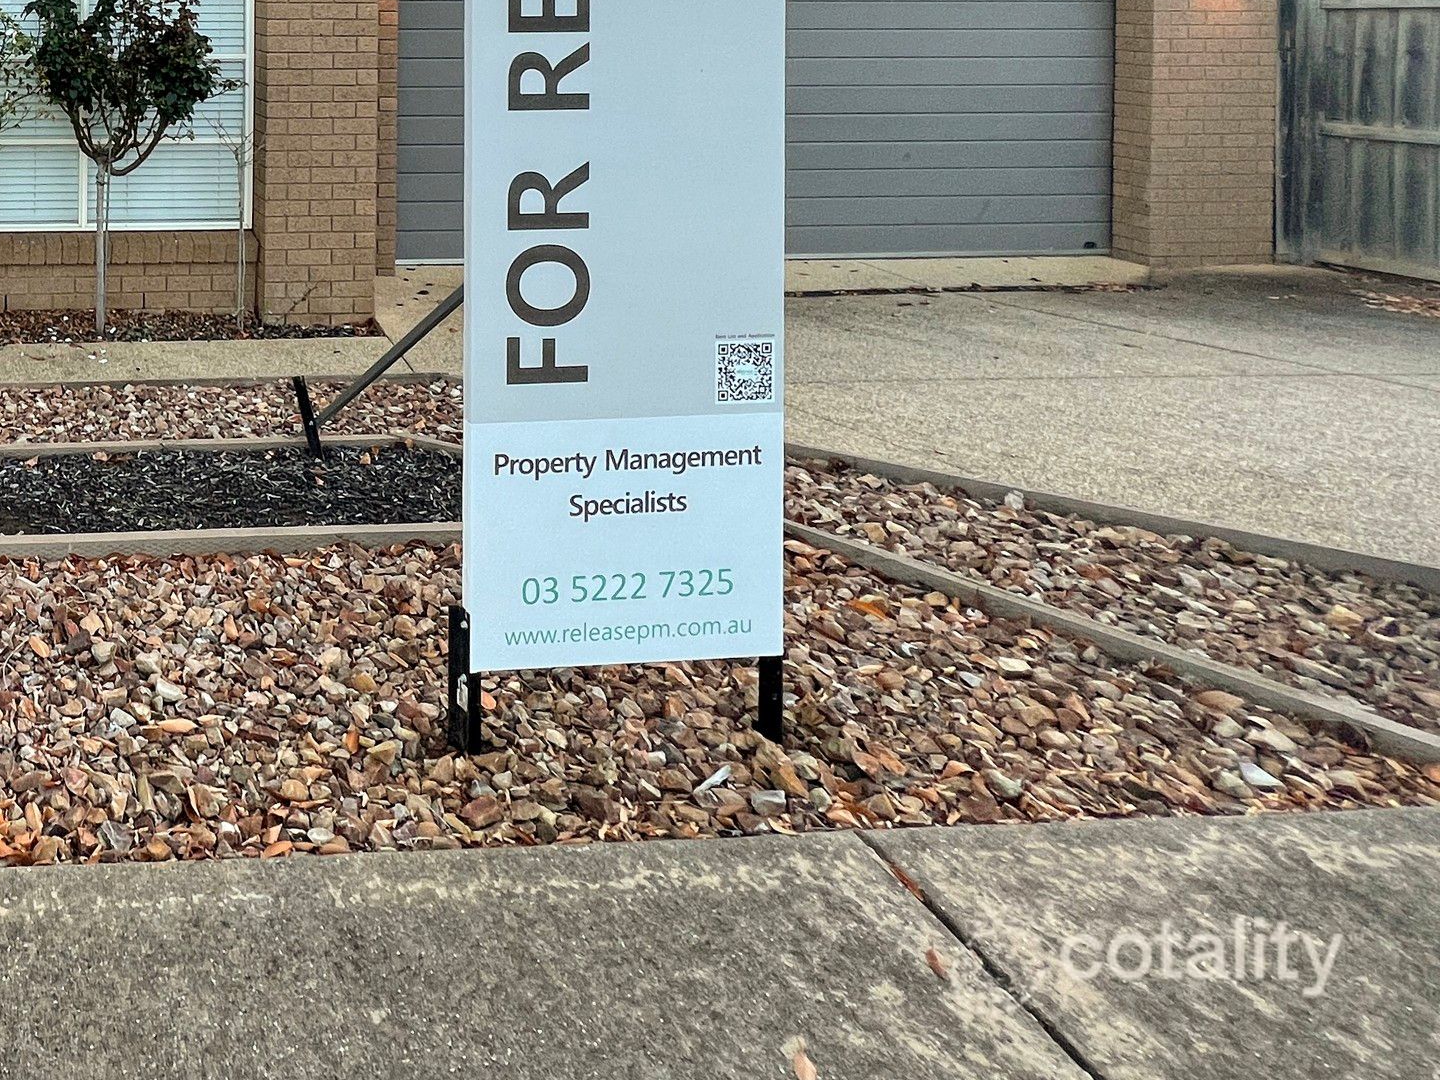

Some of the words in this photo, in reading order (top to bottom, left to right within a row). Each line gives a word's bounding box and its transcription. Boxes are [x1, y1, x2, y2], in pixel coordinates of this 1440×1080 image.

[506, 161, 591, 385] FOR
[494, 451, 597, 480] Property
[605, 445, 762, 475] Management
[569, 491, 688, 522] Specialists
[521, 577, 560, 606] 03
[570, 572, 647, 603] 5222
[659, 568, 735, 599] 7325
[504, 617, 753, 647] www.releasepm.com.au
